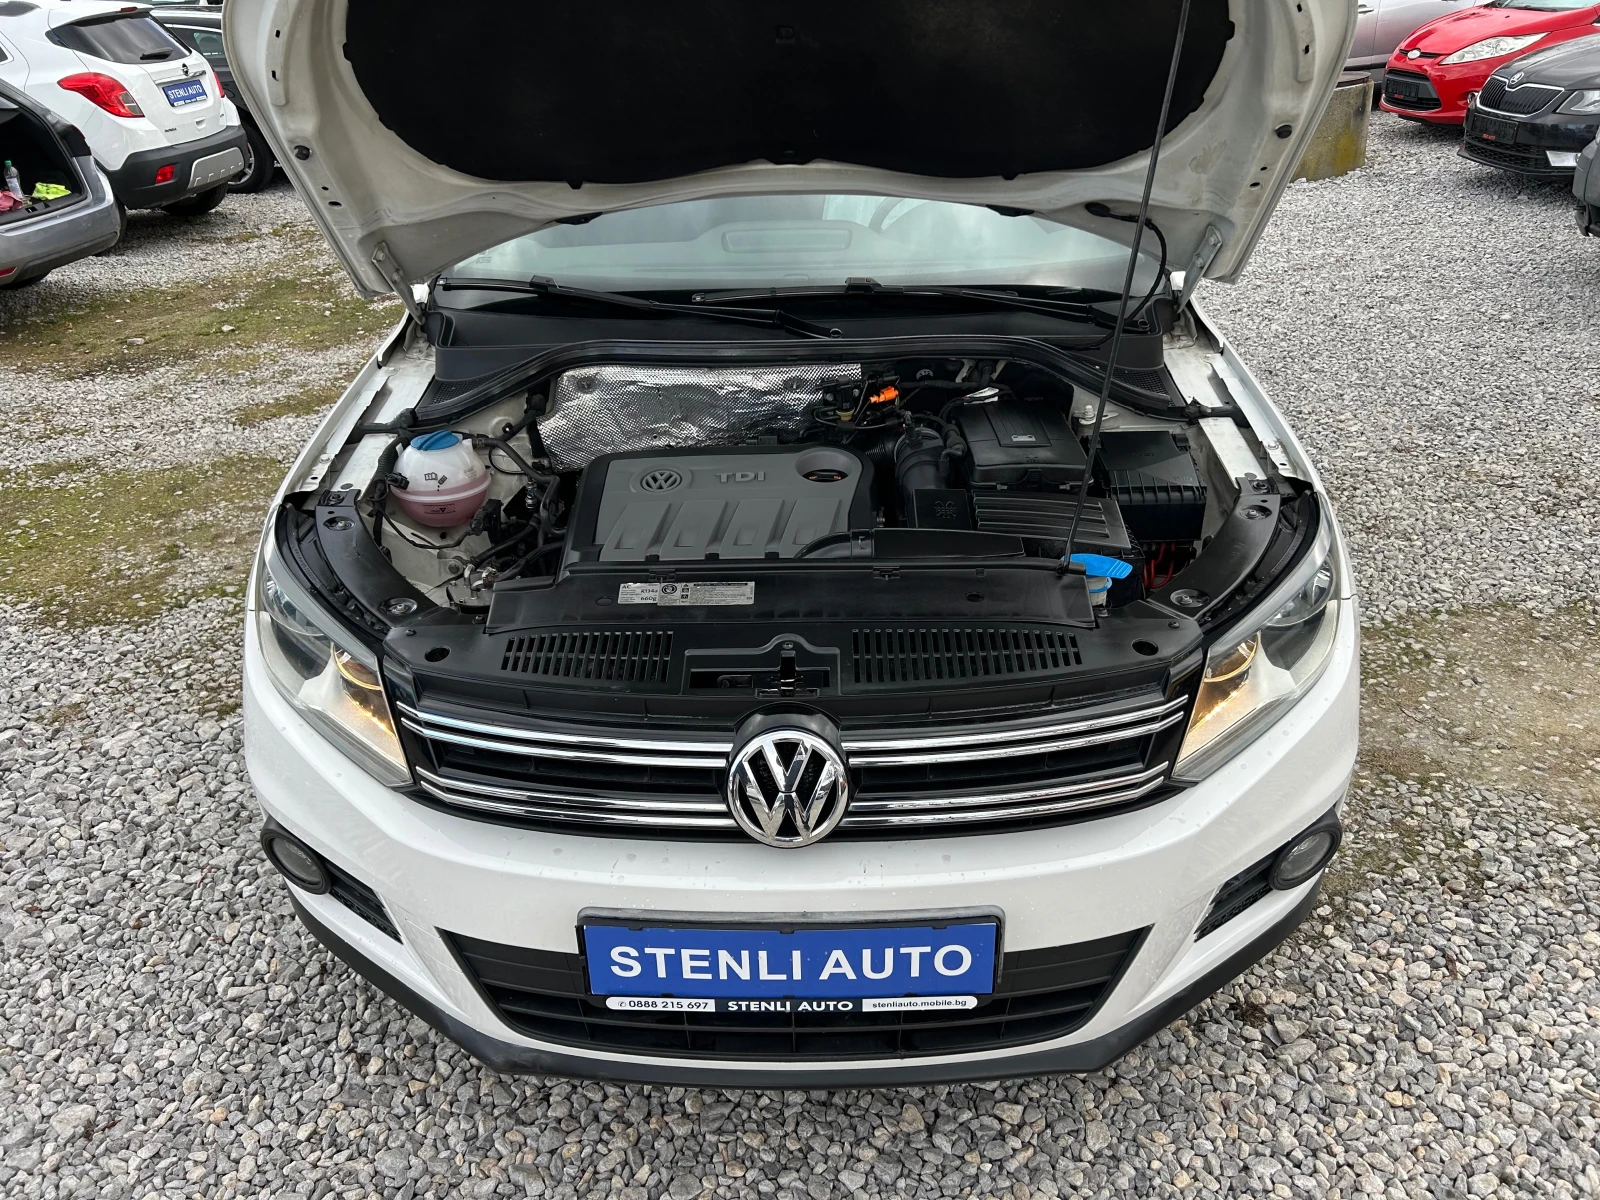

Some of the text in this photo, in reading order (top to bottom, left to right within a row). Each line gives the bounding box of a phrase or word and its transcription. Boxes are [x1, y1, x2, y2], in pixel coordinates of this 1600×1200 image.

[168, 88, 188, 99] STENLI
[189, 85, 202, 95] AUTO
[715, 471, 766, 483] TDI
[610, 944, 972, 981] STENLI AUTO
[628, 1000, 708, 1010] 0888 215 697
[727, 1000, 853, 1012] STENLI AUTO
[872, 999, 967, 1009] stenliauto.mobile.bg
